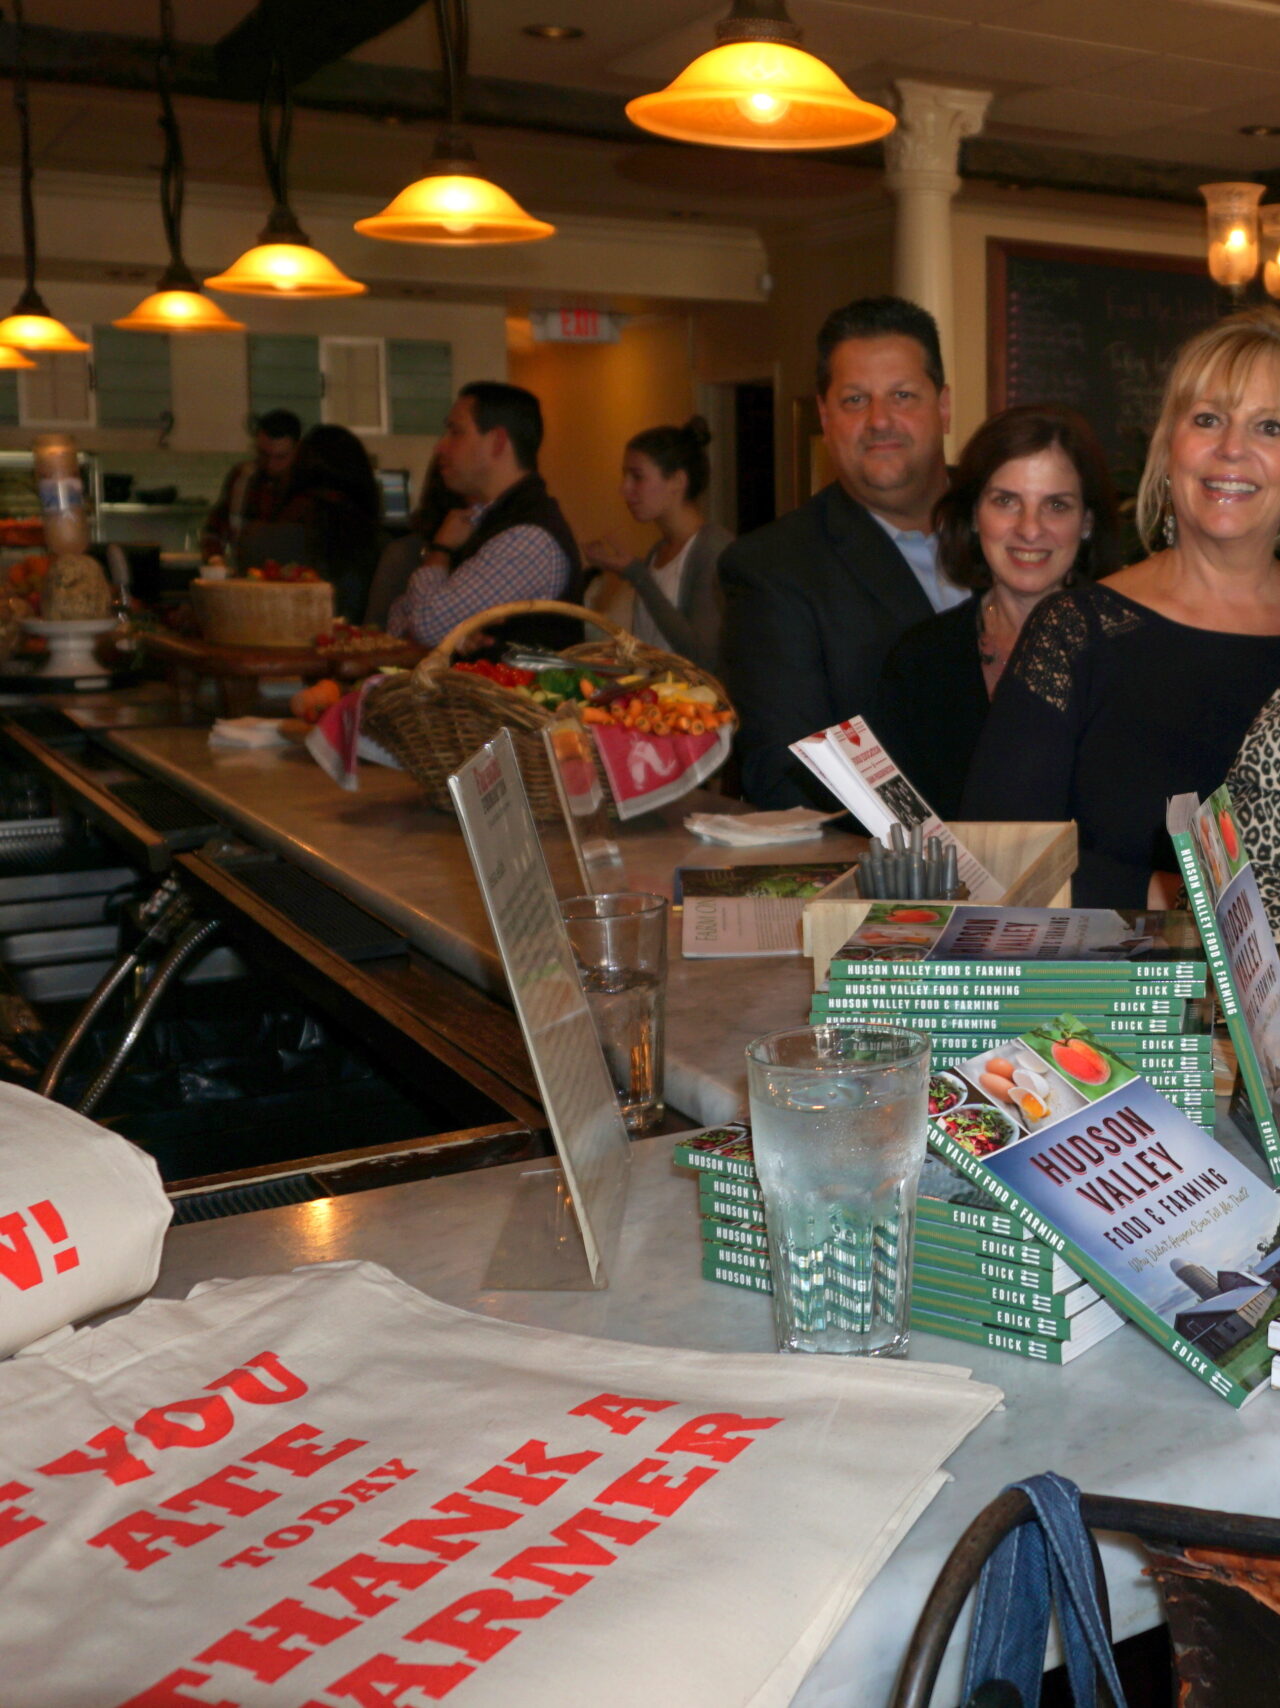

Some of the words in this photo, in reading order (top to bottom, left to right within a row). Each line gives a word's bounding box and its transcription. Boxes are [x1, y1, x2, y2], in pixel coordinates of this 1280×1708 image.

[1181, 848, 1201, 889] HUDSON
[1193, 891, 1213, 929] VALLEY
[1204, 932, 1221, 958] FOOD
[1216, 970, 1237, 1016] FARMING
[848, 964, 888, 976] HUDSON
[892, 965, 930, 976] VALLEY
[935, 965, 961, 976] FOOD
[976, 966, 1022, 977] FARMING
[1137, 966, 1169, 977] EDICK
[845, 984, 886, 995] HUDSON
[890, 985, 928, 995] VALLEY
[933, 985, 959, 995] FOOD
[974, 985, 1020, 996] FARMING
[1135, 985, 1168, 996] EDICK
[828, 998, 868, 1009] HUDSON
[872, 999, 910, 1009] VALLEY
[914, 1000, 939, 1010] FOOD
[954, 1001, 1000, 1011] FARMING
[1113, 1002, 1146, 1012] EDICK
[912, 1018, 937, 1028] FOOD
[952, 1019, 997, 1029] FARMING
[1111, 1020, 1143, 1031] EDICK
[942, 1038, 967, 1048] FOOD
[1141, 1039, 1174, 1050] EDICK
[1141, 1058, 1174, 1068] EDICK
[1260, 1120, 1278, 1152] EDICK
[1029, 1105, 1155, 1188] HUDSON
[688, 1152, 723, 1172] HUDSON
[727, 1161, 754, 1178] VALLE
[1076, 1141, 1184, 1216] VALLEY
[713, 1181, 749, 1199] HUDSON
[945, 1141, 983, 1176] VALLEY
[982, 1175, 1010, 1203] FOOD
[1019, 1207, 1066, 1252] FARMING
[714, 1202, 749, 1220] HUDSON
[1103, 1215, 1152, 1250] FOOD
[1157, 1167, 1229, 1217] FARMING
[953, 1210, 986, 1227] EDICK
[716, 1227, 751, 1245] HUDSON
[719, 1249, 756, 1267] HUDSON
[982, 1240, 1015, 1258] EDICK
[715, 1267, 751, 1286] HUDSON
[981, 1263, 1014, 1280] EDICK
[992, 1287, 1026, 1305] EDICK
[997, 1311, 1031, 1329] EDICK
[988, 1333, 1022, 1351] EDICK
[1171, 1340, 1208, 1375] EDICK
[35, 1351, 309, 1487] YOU
[567, 1392, 679, 1436] A
[86, 1423, 369, 1572] ATE
[219, 1458, 419, 1569] TODAY
[300, 1412, 784, 1708] ARMER
